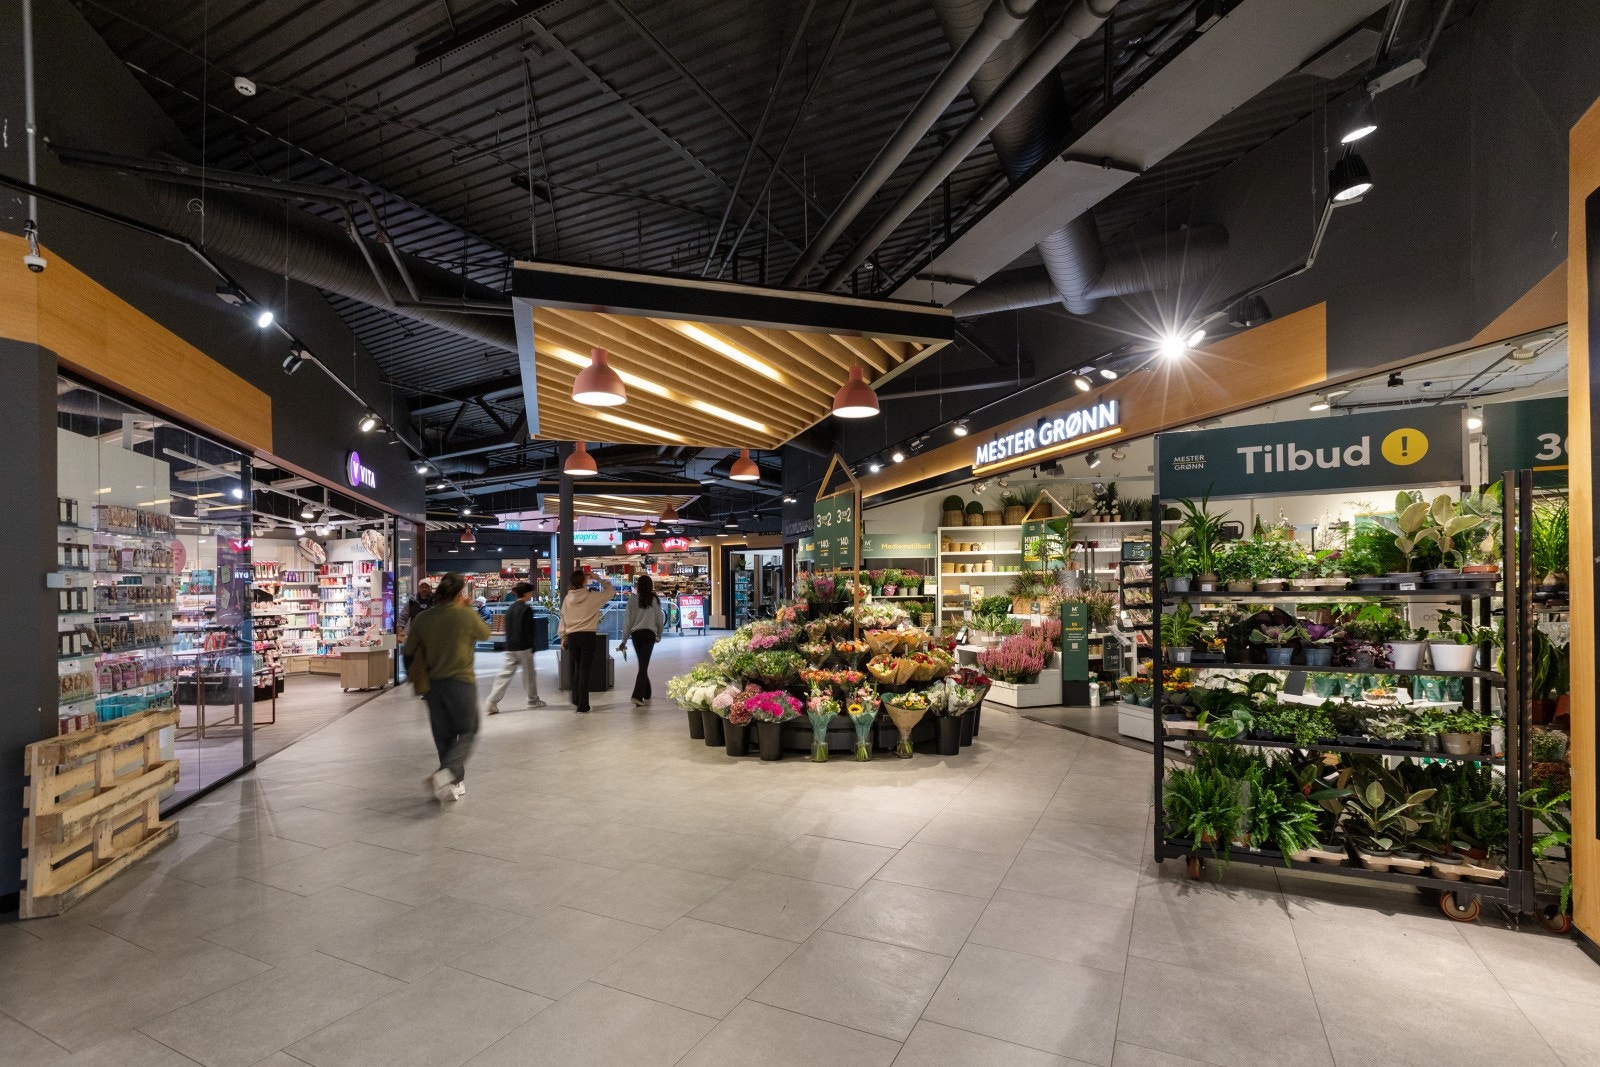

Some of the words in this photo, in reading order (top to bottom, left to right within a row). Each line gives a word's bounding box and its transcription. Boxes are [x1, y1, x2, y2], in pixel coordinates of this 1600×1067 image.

[976, 428, 1035, 465] MESTER
[1039, 400, 1119, 445] GRØNN
[1237, 436, 1370, 474] Tilbud
[360, 464, 376, 489] VITA
